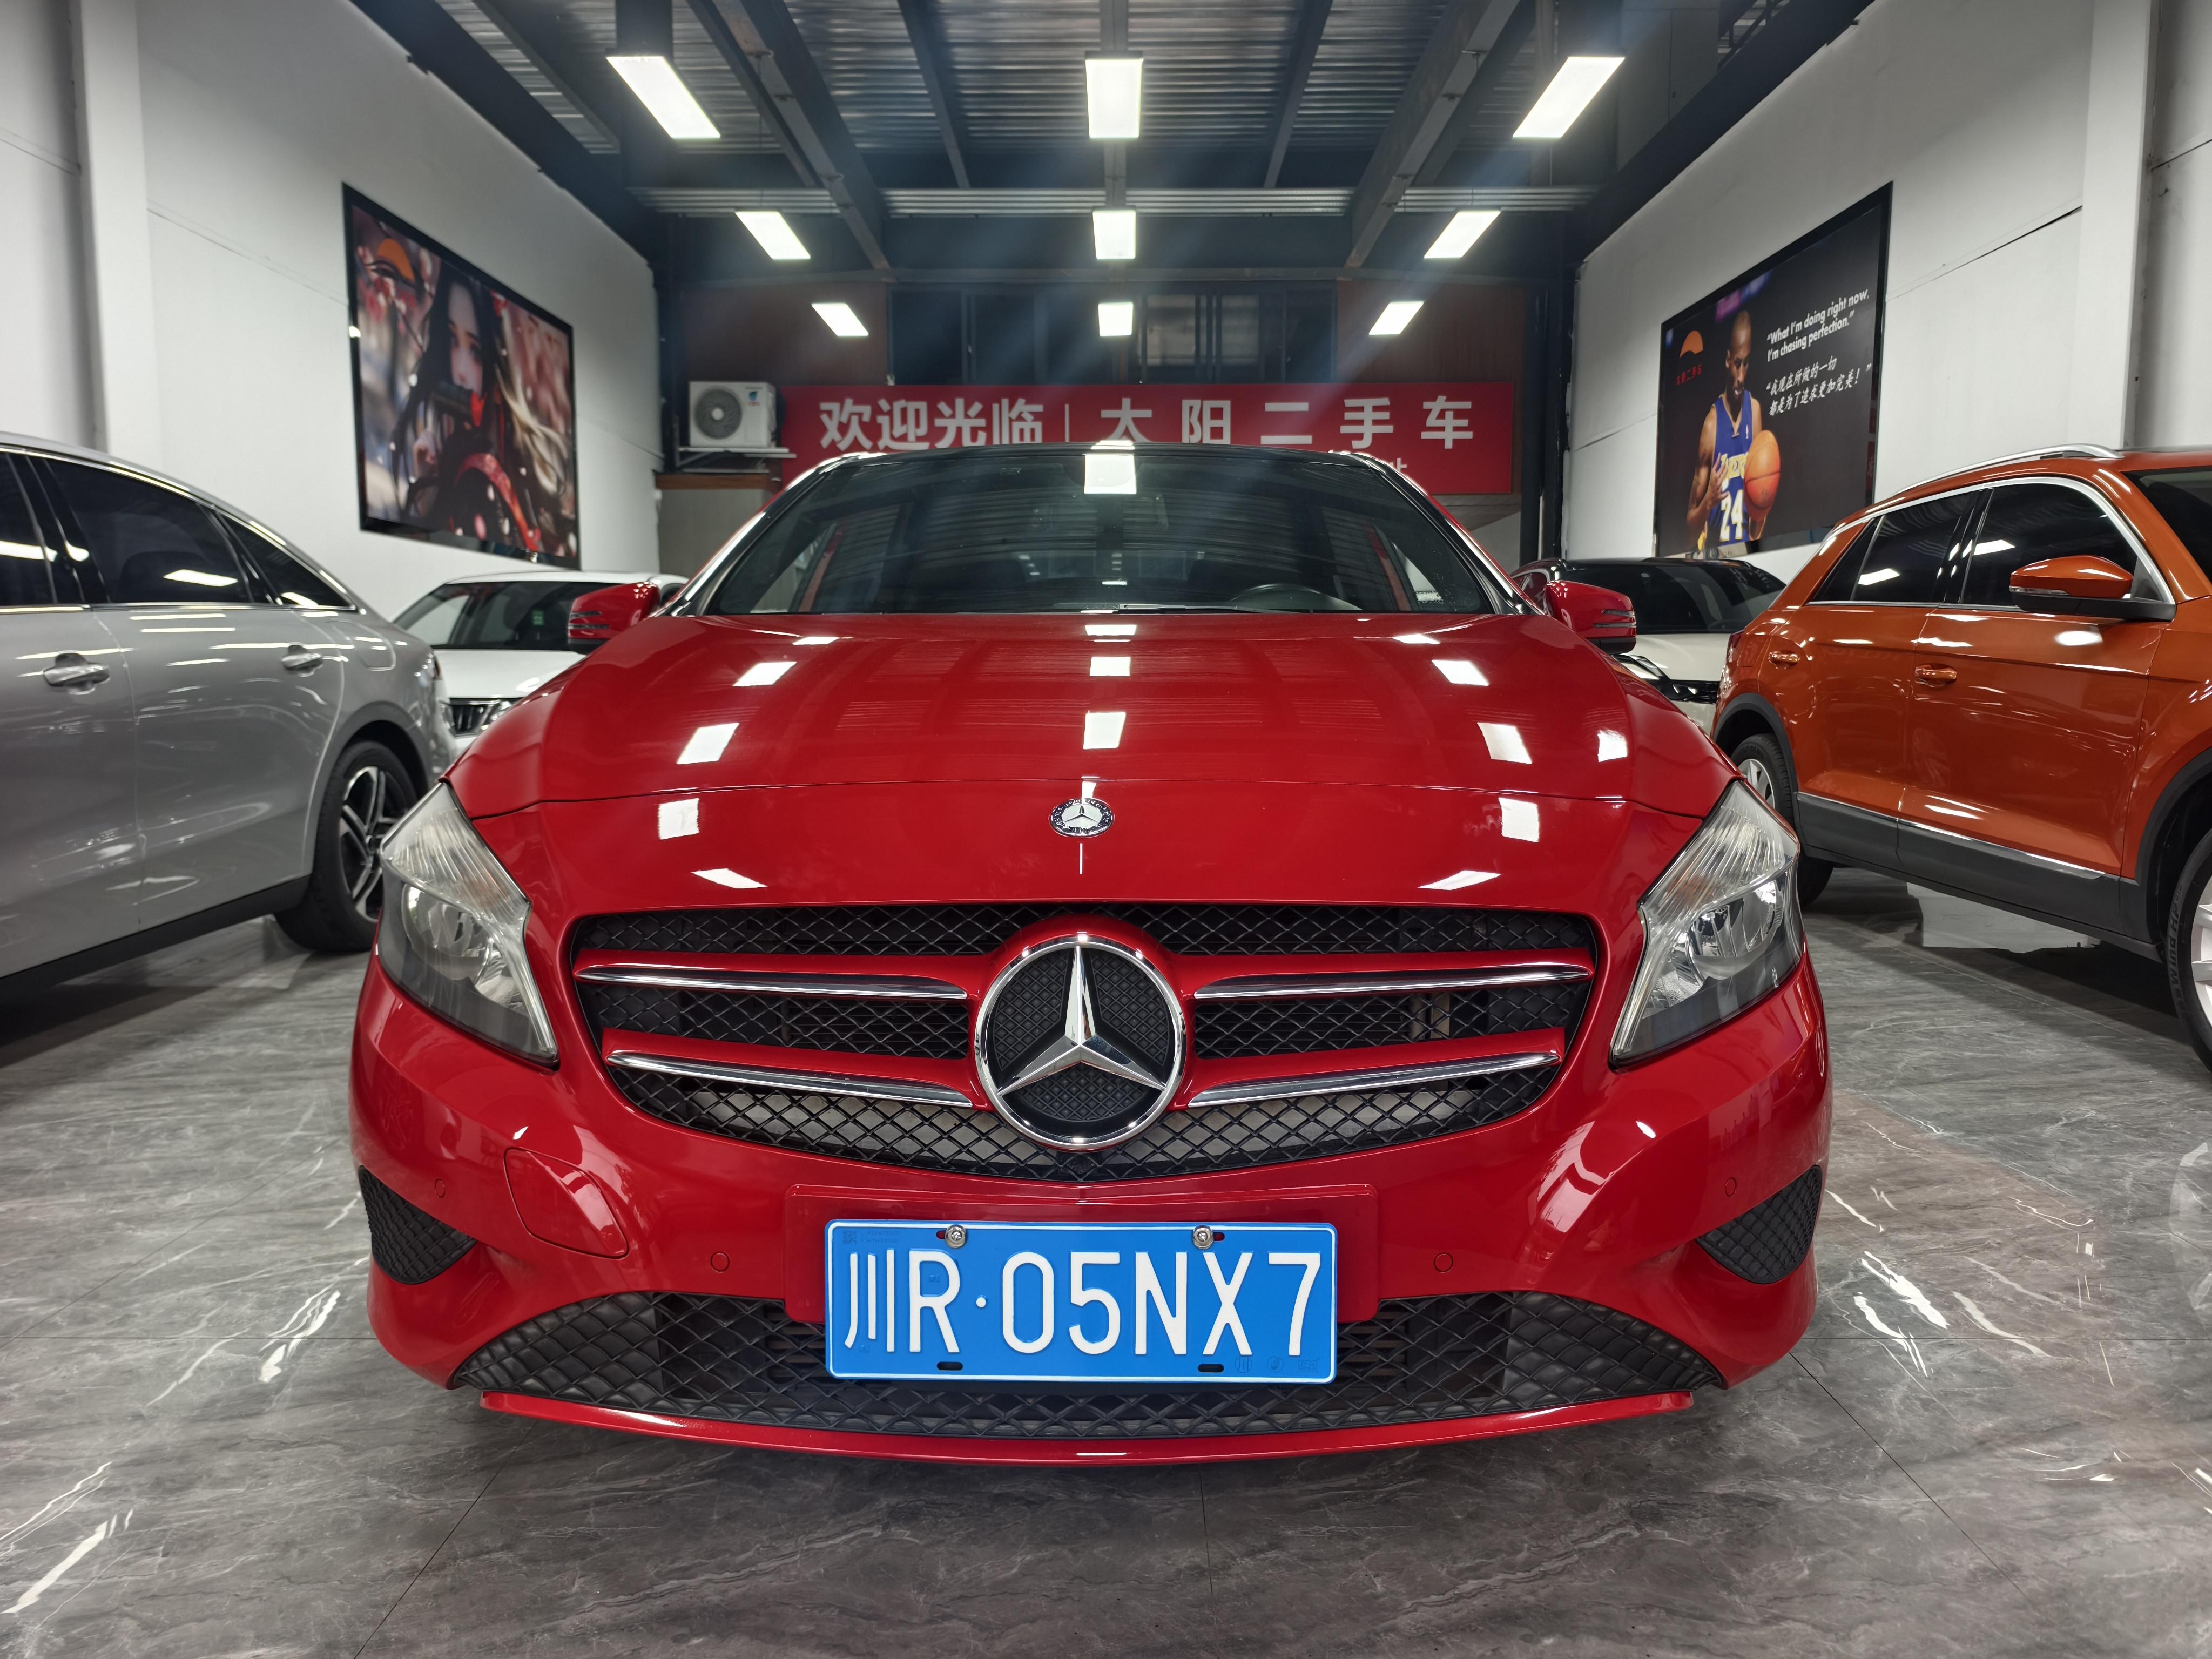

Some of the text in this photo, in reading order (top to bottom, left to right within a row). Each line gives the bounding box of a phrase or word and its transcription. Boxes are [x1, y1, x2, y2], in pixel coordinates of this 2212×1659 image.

[1790, 321, 1802, 335] I'm
[1804, 310, 1825, 328] doing
[1827, 297, 1847, 318] right
[1849, 289, 1869, 307] now.
[1768, 349, 1779, 362] I'm
[1781, 336, 1807, 356] chasing
[819, 396, 1473, 450] 欢迎光临 太阳二手车
[1719, 489, 1743, 542] 24
